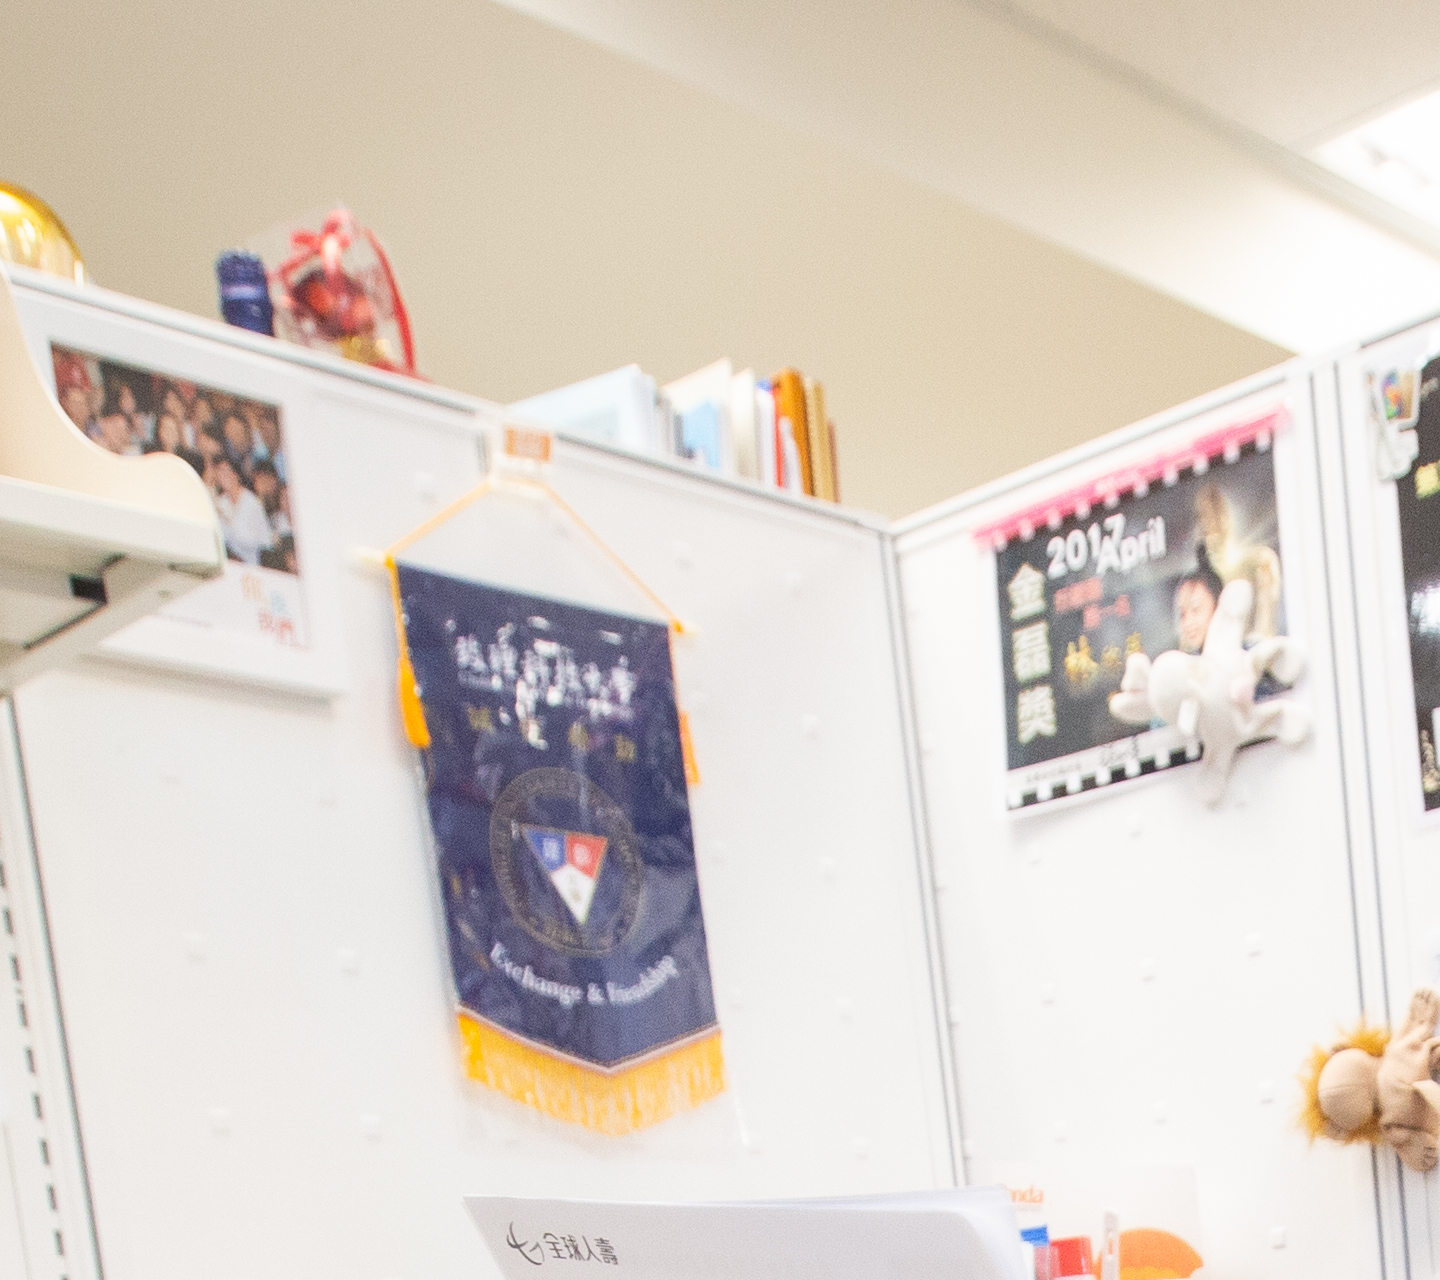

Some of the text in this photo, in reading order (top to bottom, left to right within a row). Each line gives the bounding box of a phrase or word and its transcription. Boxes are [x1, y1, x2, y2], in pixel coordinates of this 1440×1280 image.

[1046, 513, 1126, 579] 2017
[1095, 516, 1167, 577] April
[1007, 561, 1058, 747] 金磊獎
[490, 940, 585, 1009] Exchange
[587, 982, 605, 1005] &
[543, 1231, 619, 1266] 全球人壽
